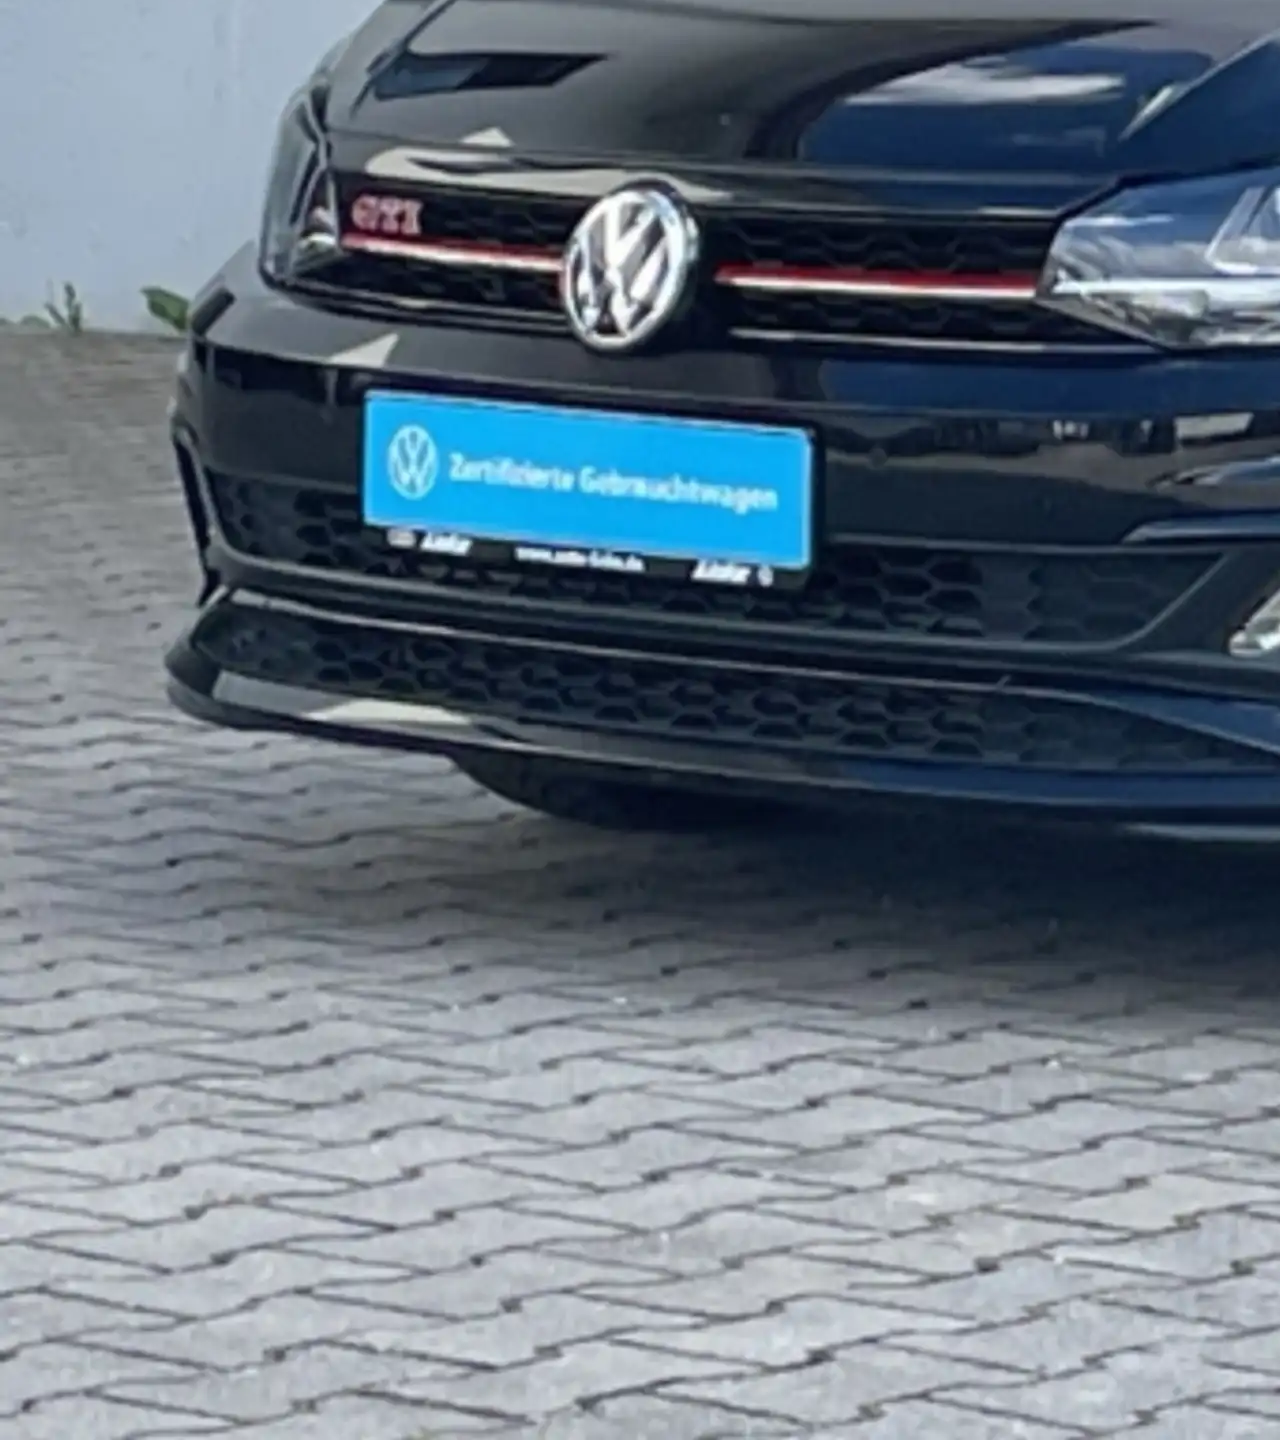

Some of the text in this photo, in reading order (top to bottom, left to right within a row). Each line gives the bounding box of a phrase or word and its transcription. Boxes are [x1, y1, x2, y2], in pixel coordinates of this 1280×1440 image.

[351, 193, 424, 235] GTI
[566, 191, 689, 348] VW
[449, 452, 778, 515] Zertifizierte Gebrauchtwagen
